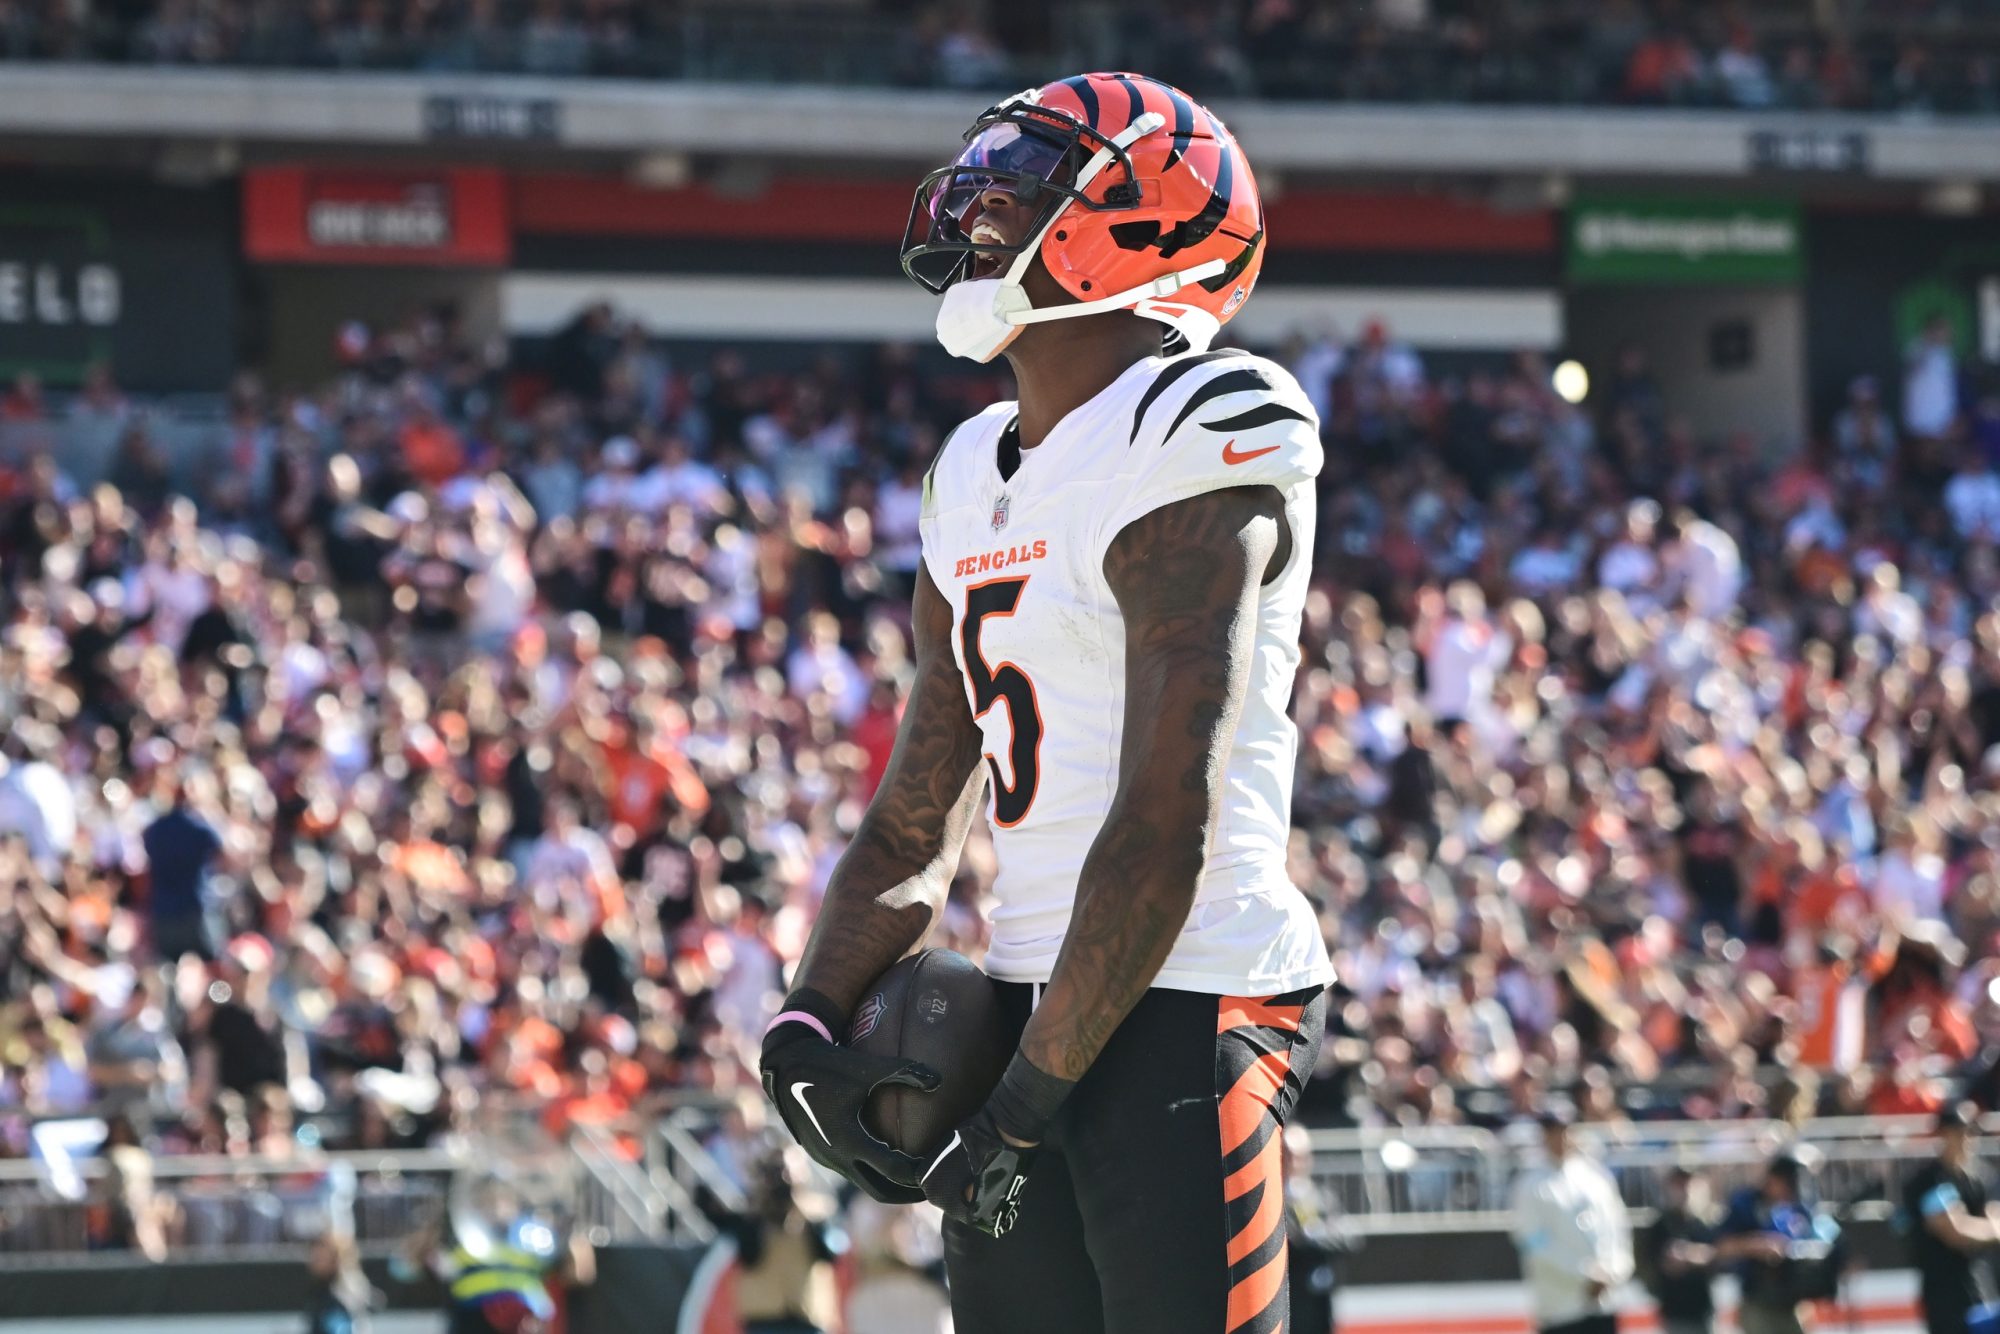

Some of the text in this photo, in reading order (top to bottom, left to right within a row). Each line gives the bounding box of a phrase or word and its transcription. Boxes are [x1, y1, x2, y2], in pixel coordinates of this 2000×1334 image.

[954, 540, 1047, 578] BENGALS
[962, 575, 1044, 828] 5
[931, 998, 948, 1015] 122
